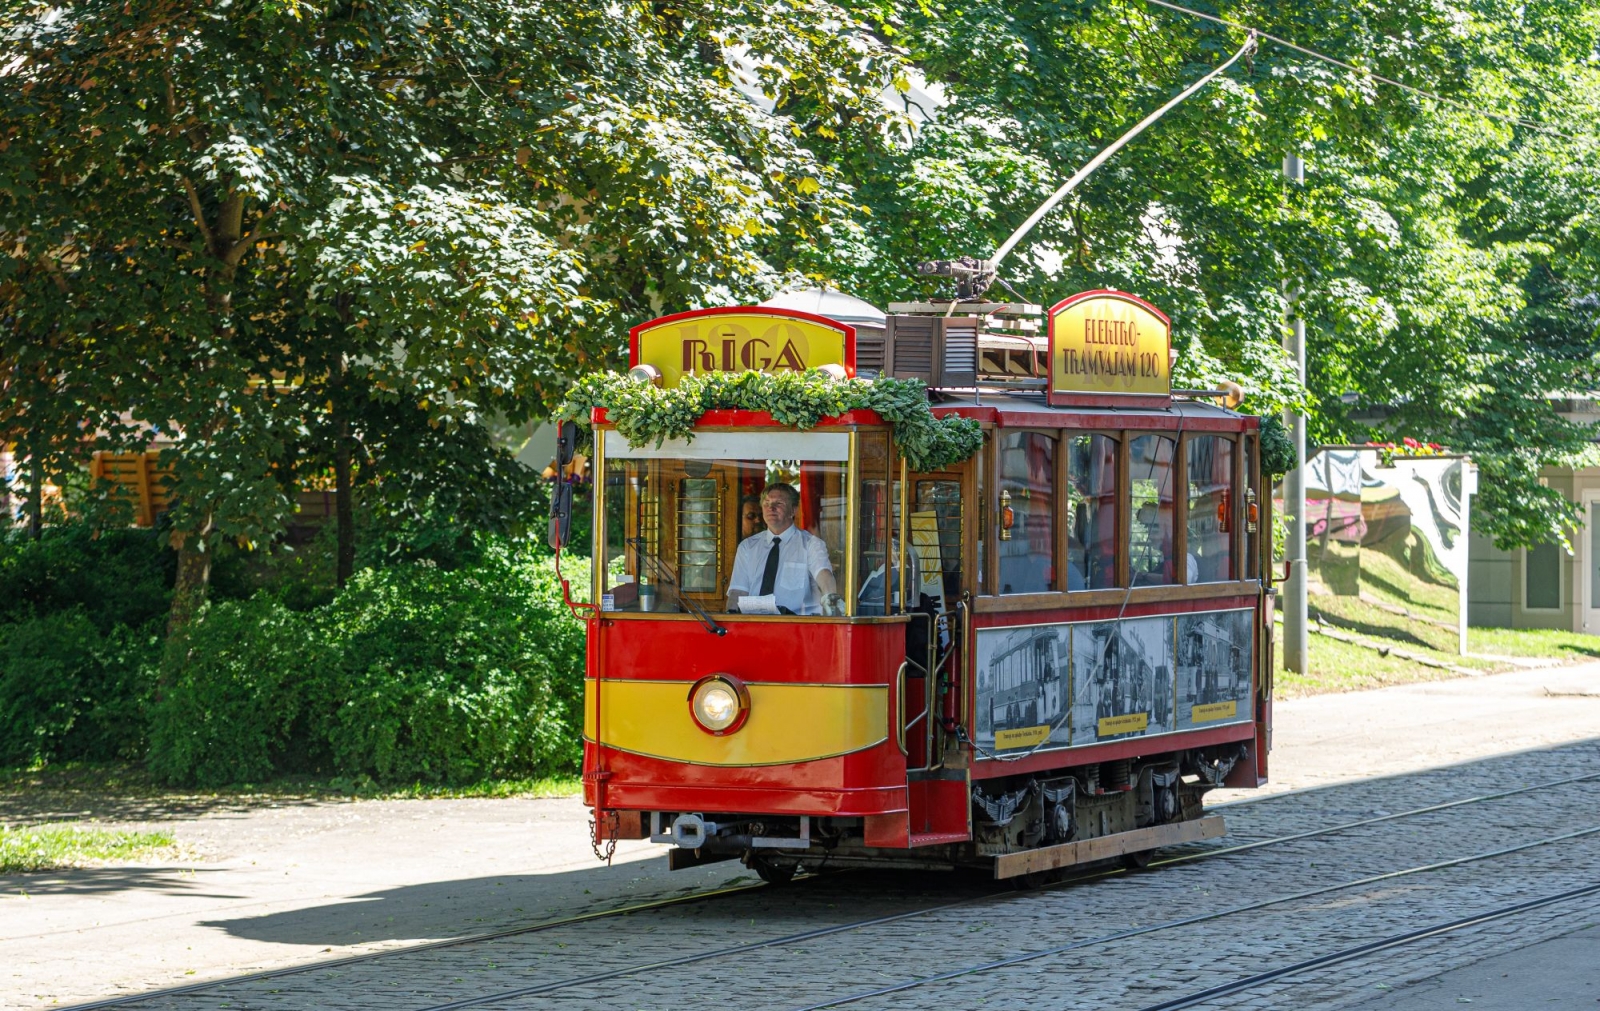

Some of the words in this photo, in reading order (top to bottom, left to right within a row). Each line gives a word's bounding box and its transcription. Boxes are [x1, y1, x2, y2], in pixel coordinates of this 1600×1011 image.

[1085, 318, 1141, 347] ELEKTRO-
[682, 333, 807, 372] RĪGA
[1062, 348, 1137, 377] TRAMVAJAM
[1140, 352, 1160, 379] 120
